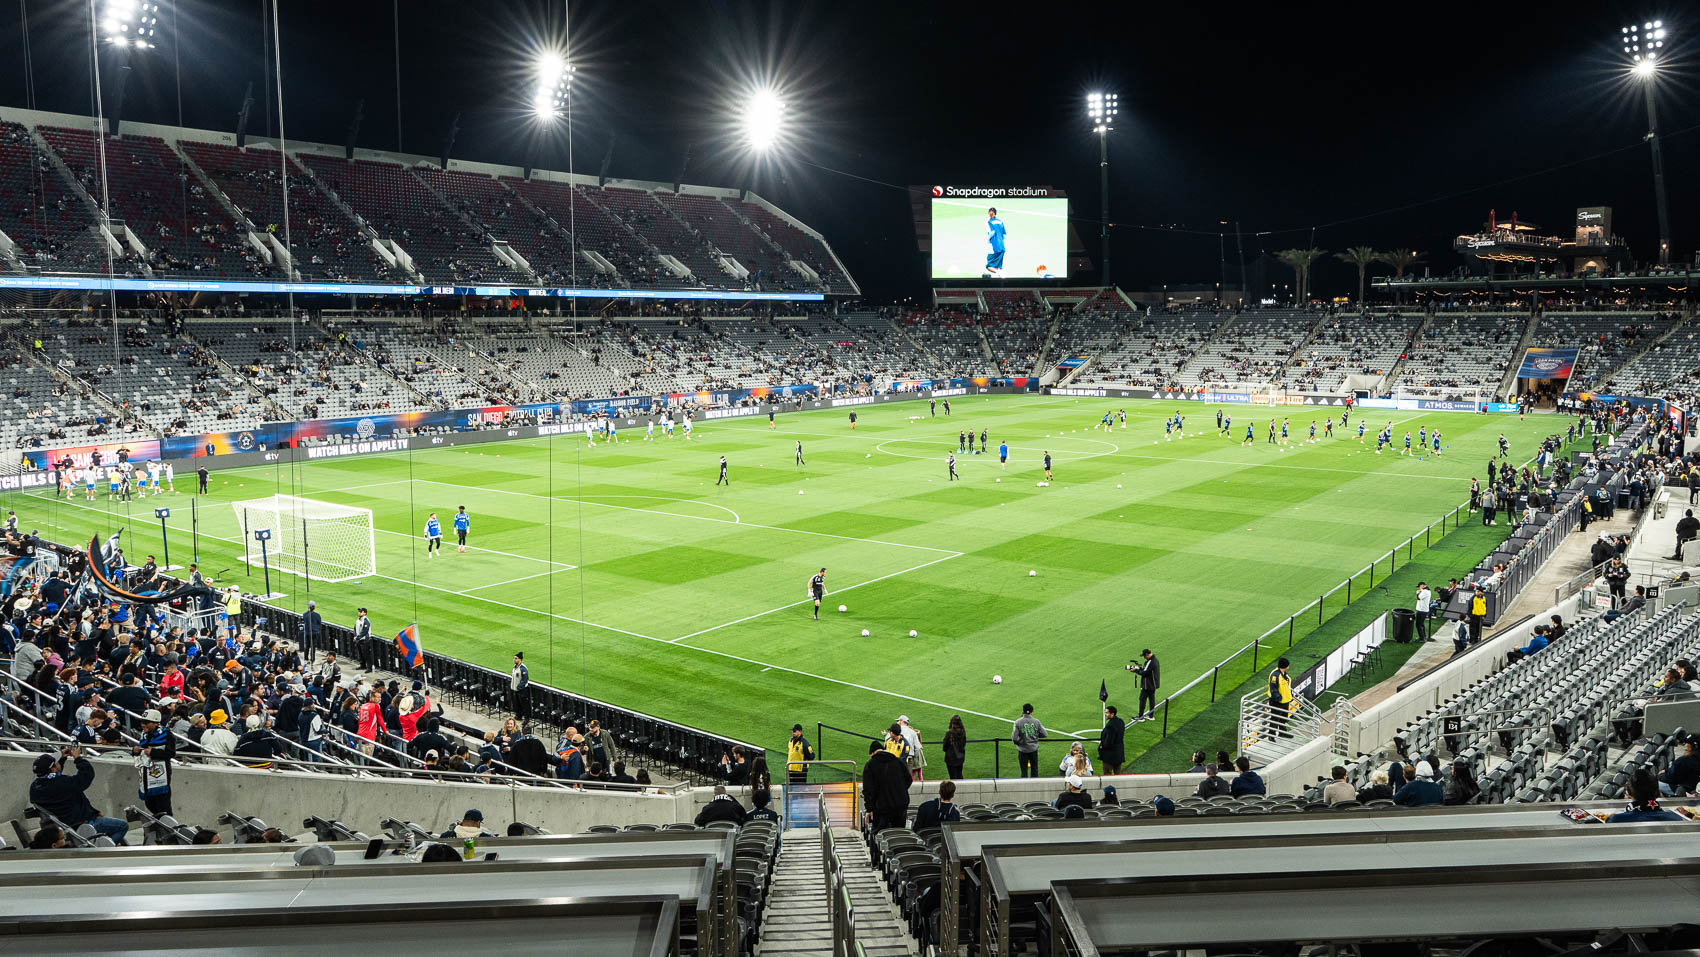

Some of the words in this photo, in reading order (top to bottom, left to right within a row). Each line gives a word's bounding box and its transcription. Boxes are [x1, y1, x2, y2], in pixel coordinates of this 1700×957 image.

[946, 186, 1006, 198] Snapdragon
[1007, 186, 1048, 196] stadium
[467, 413, 483, 425] SAN
[484, 411, 502, 424] DIEGO
[538, 424, 560, 435] WATCH
[308, 446, 338, 459] WATCH
[339, 443, 358, 455] MLS
[358, 442, 371, 453] ON
[371, 440, 397, 453] APPLE
[397, 438, 408, 449] TV
[21, 473, 47, 487] MLS
[1448, 723, 1458, 731] 134
